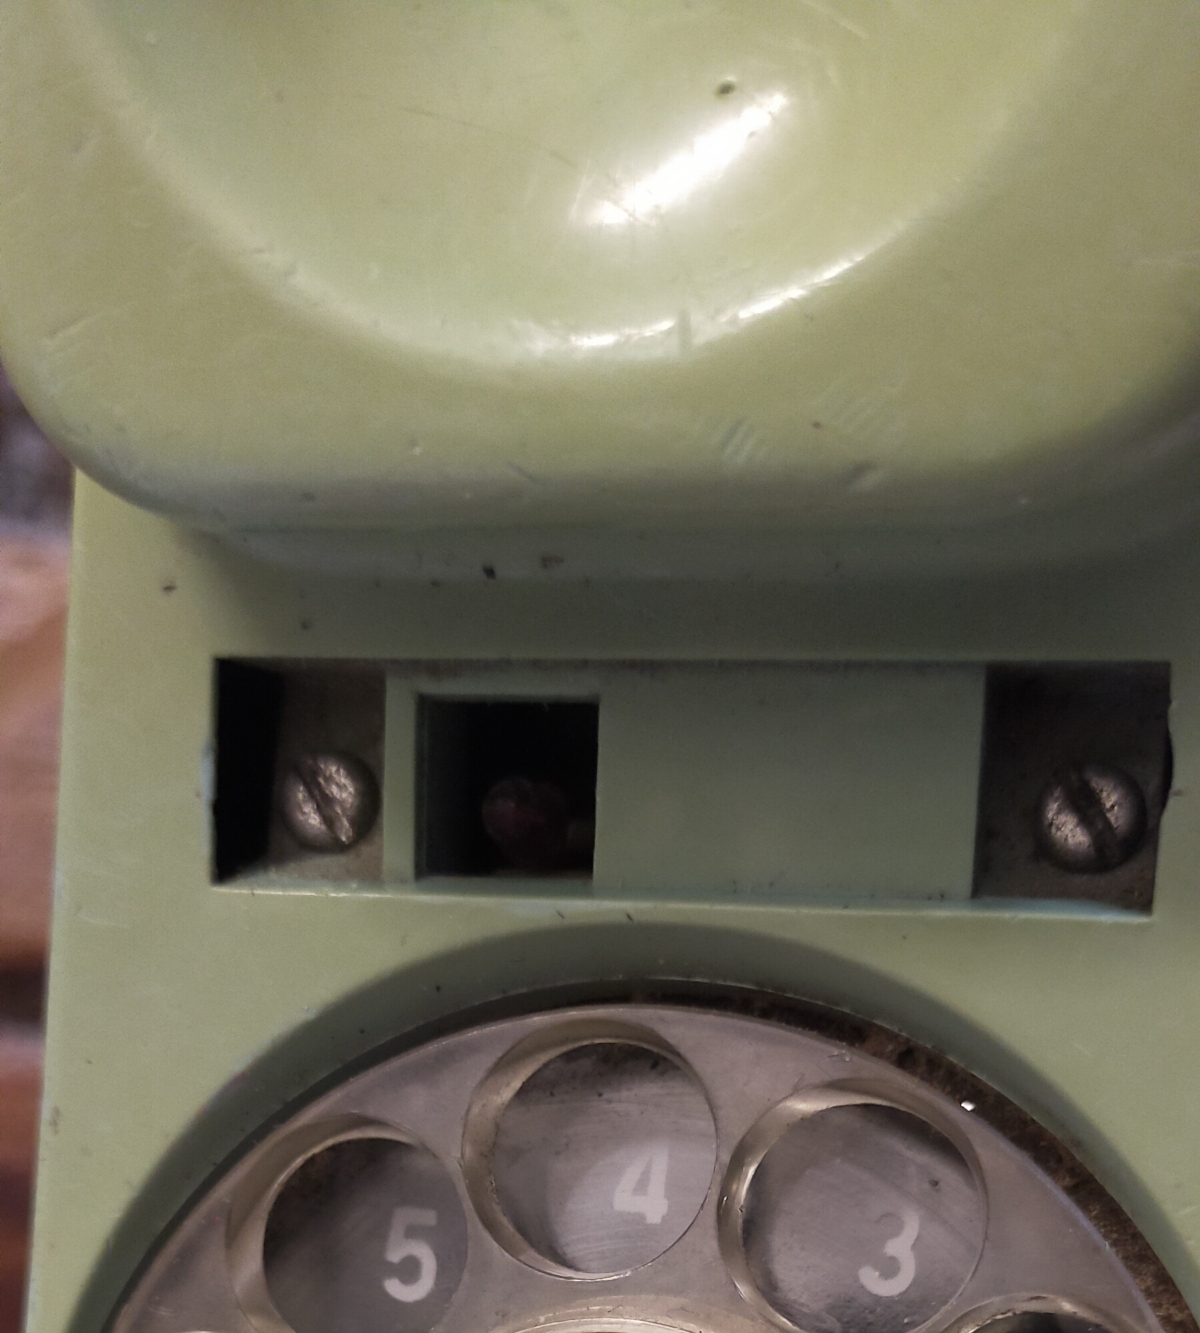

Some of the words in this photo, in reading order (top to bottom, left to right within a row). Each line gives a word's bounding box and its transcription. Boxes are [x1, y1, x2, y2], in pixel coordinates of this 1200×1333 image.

[613, 1151, 670, 1225] 4
[383, 1208, 439, 1302] 5
[857, 1210, 921, 1298] 3
